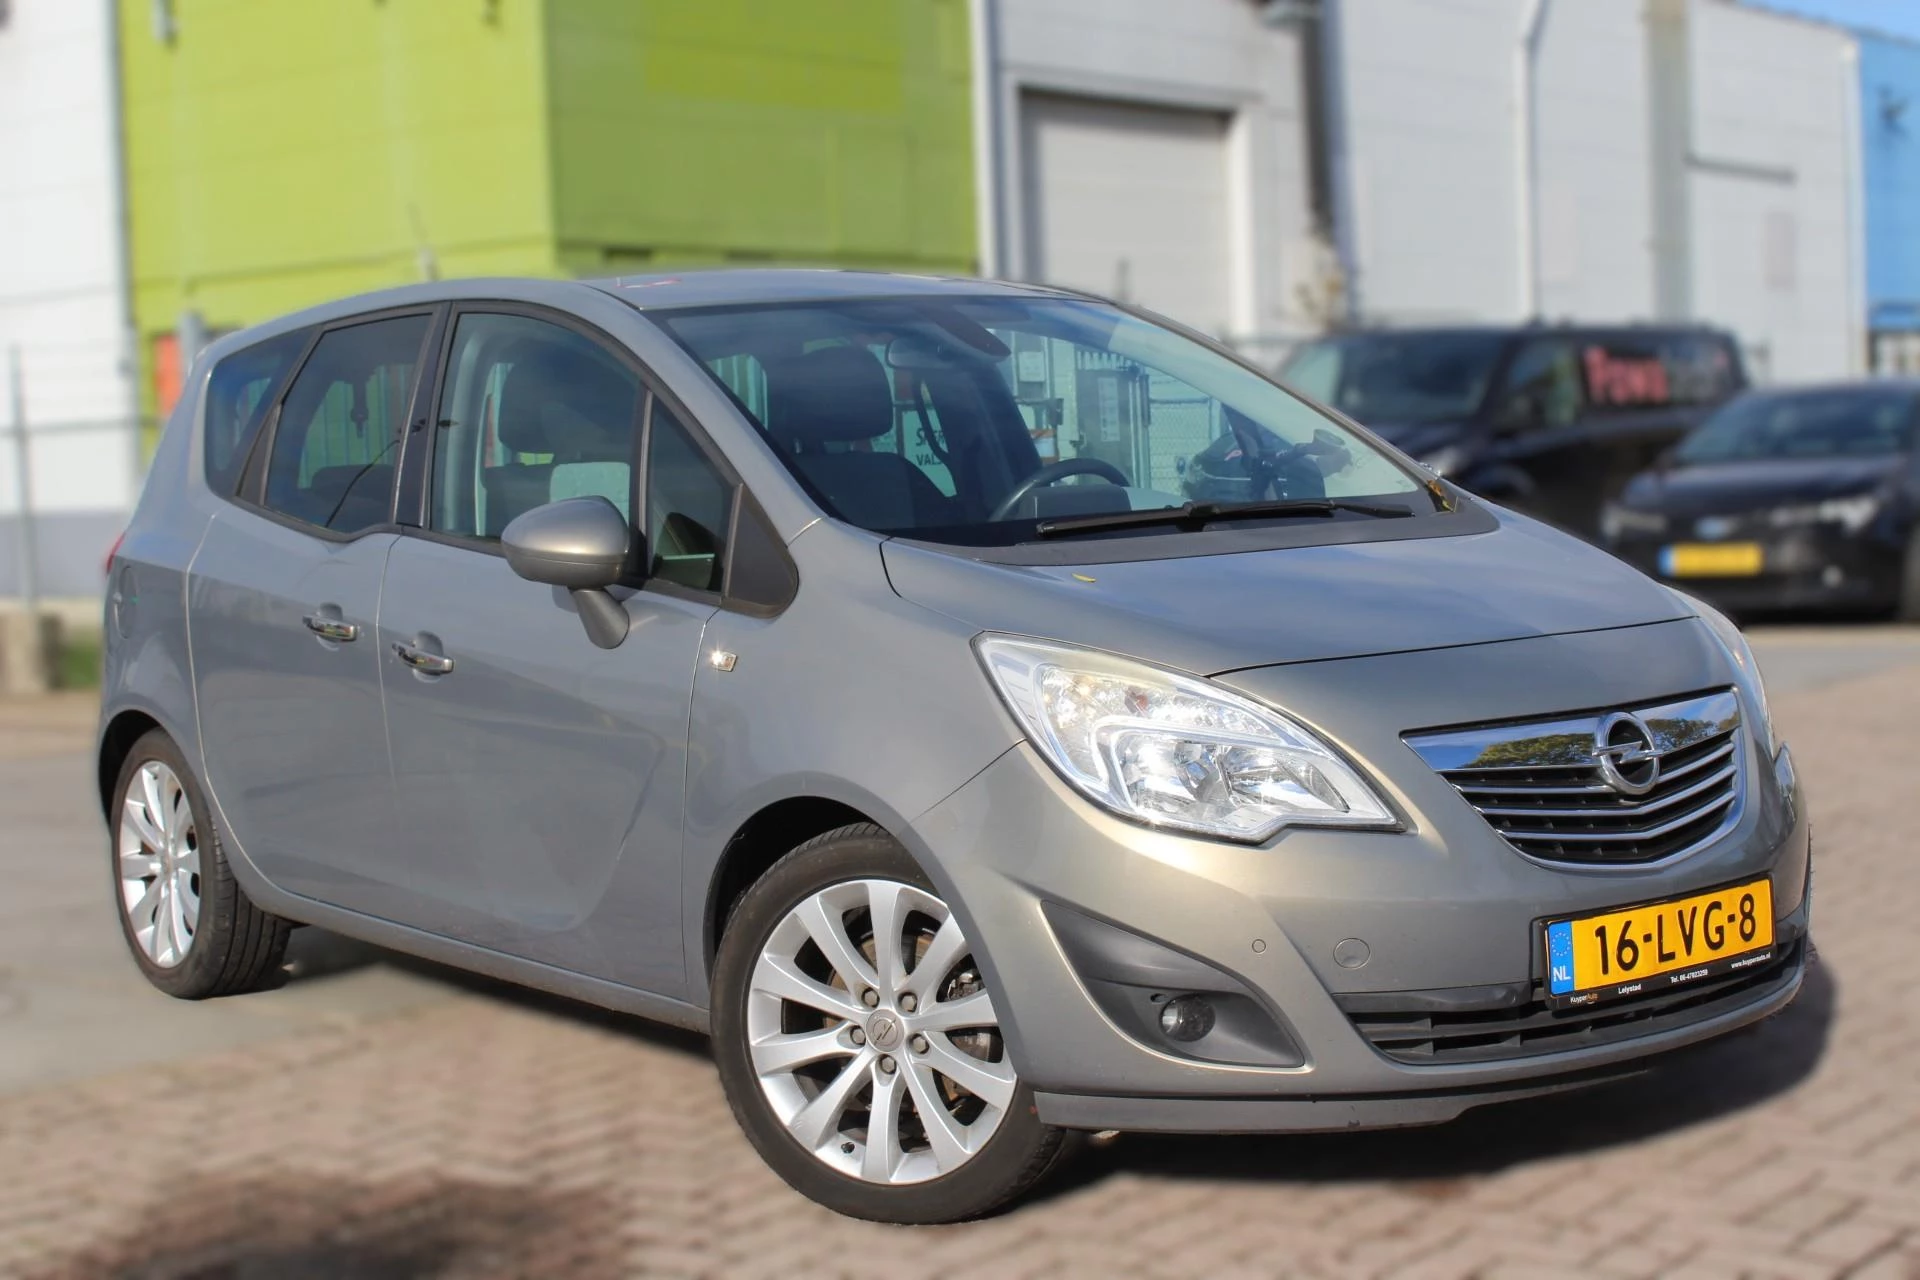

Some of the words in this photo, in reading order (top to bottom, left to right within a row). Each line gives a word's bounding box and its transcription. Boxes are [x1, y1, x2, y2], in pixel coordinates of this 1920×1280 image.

[1595, 893, 1757, 975] 16-LVG-8
[1552, 966, 1571, 982] NL
[1618, 983, 1642, 995] Lelystad
